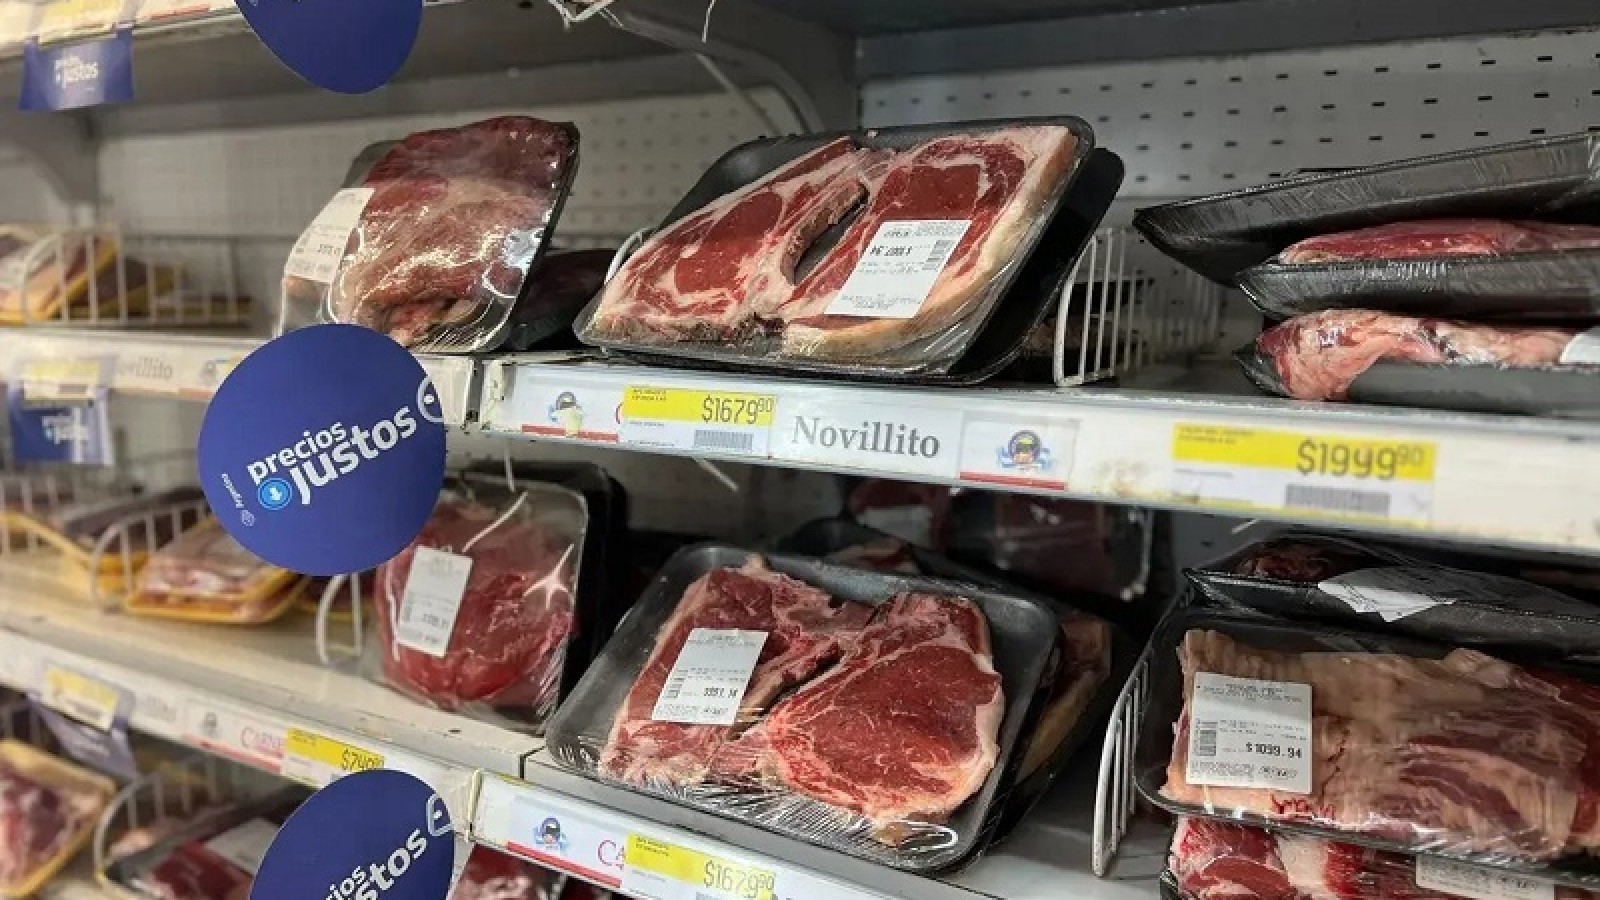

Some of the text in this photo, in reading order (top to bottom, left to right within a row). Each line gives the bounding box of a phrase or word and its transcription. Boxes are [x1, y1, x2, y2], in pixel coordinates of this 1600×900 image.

[247, 422, 347, 485] precios
[289, 406, 417, 505] justos
[791, 415, 941, 459] Novillito
